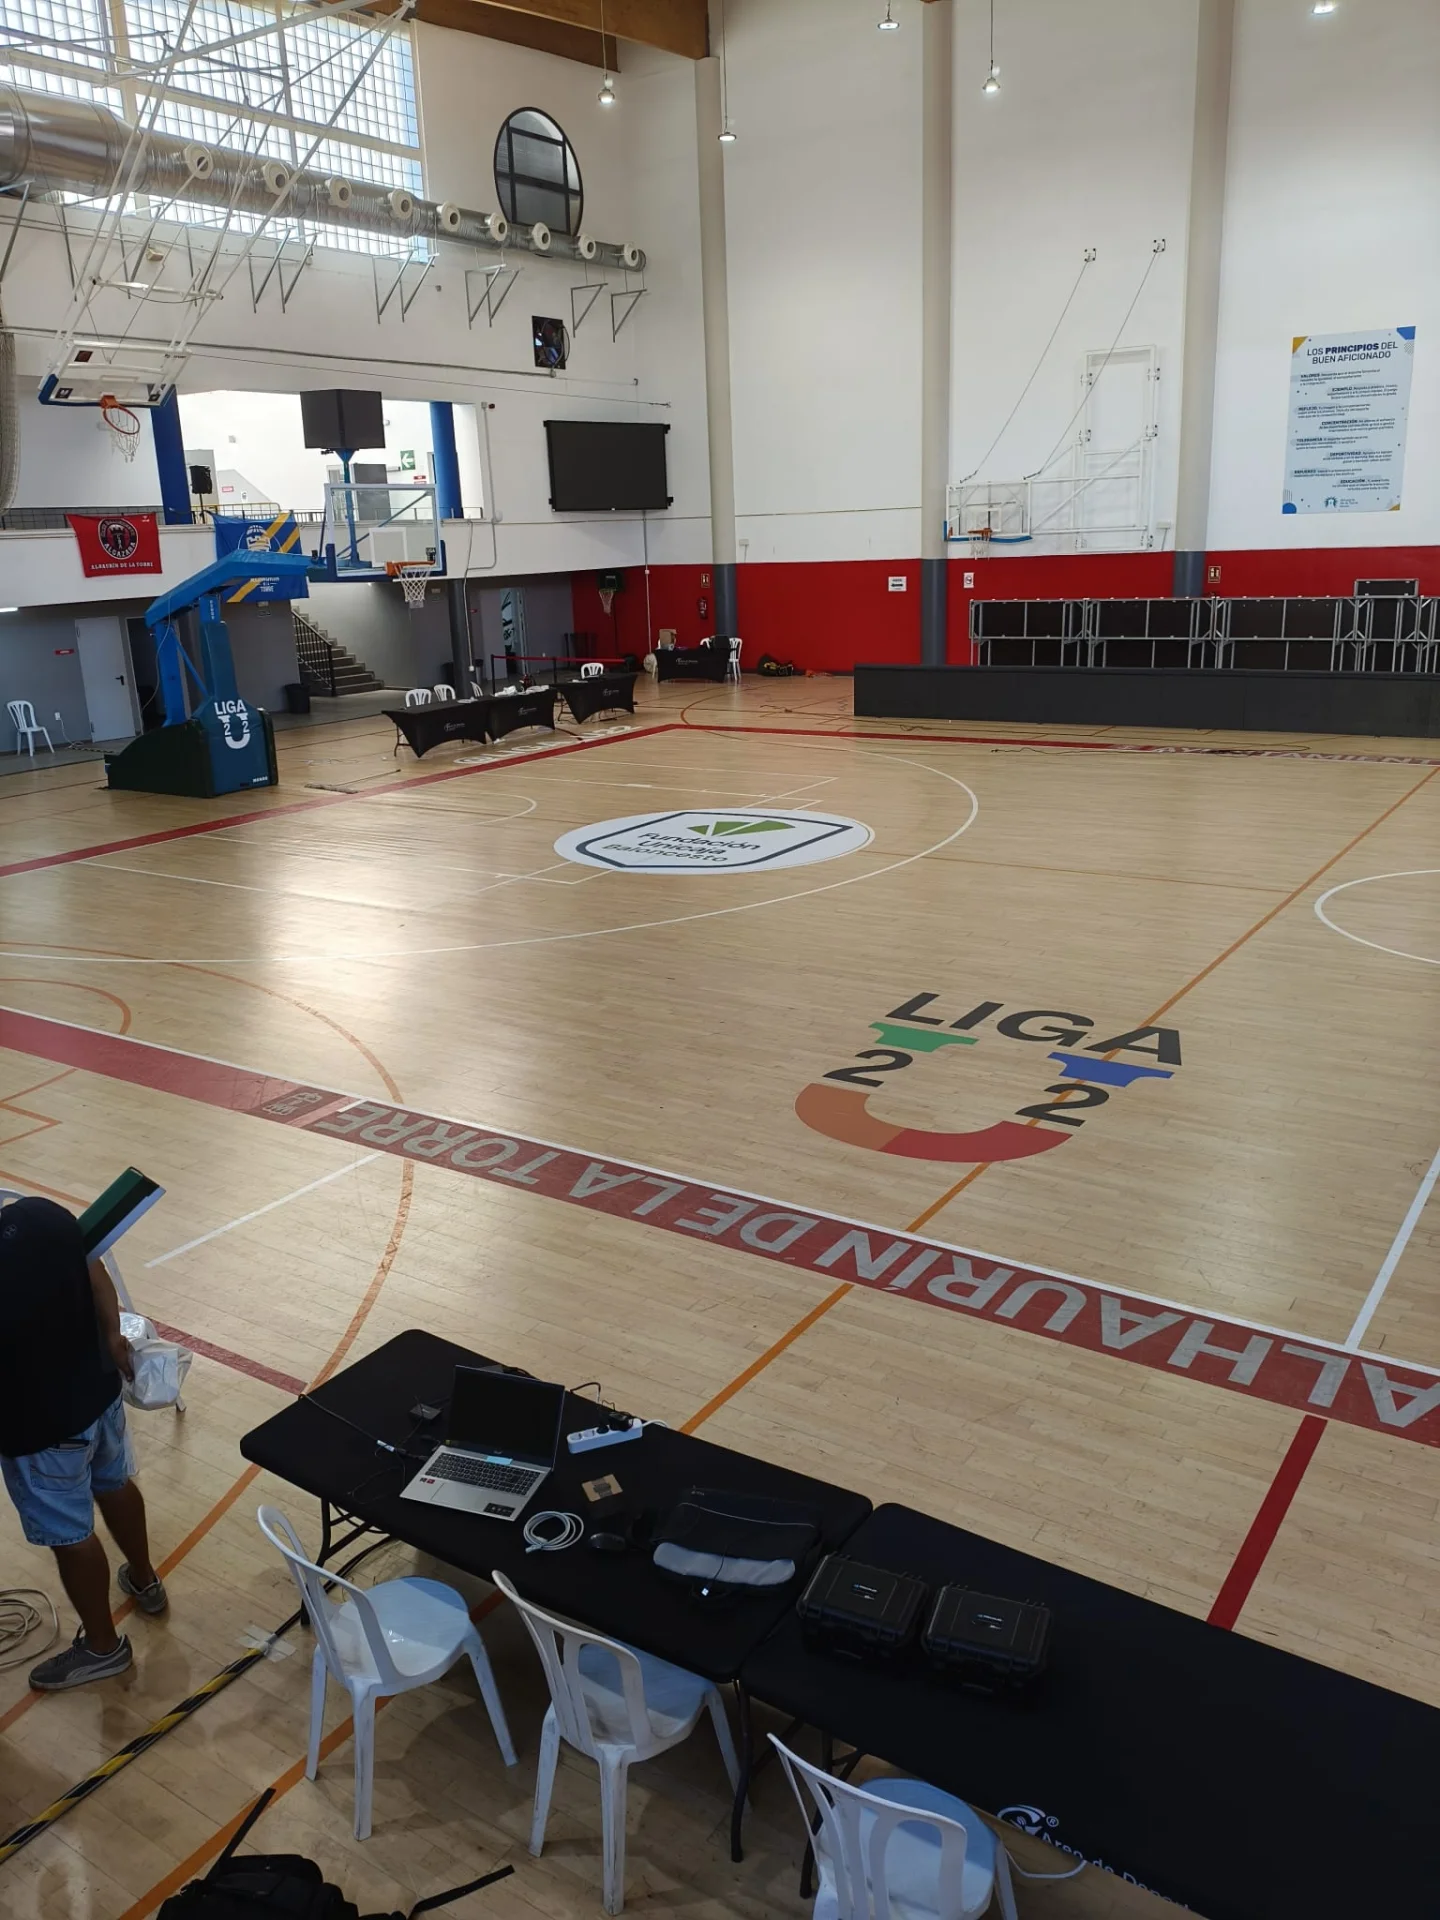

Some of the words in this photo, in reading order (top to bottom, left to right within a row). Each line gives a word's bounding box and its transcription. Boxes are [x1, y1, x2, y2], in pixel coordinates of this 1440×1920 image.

[1307, 348, 1324, 356] LOS
[1325, 343, 1379, 355] PRINCIPIOS
[1381, 341, 1398, 349] DEL
[1312, 356, 1336, 364] BUEN
[1337, 351, 1391, 362] AFICIONADO
[214, 699, 247, 715] LIGA
[638, 832, 761, 850] Fundación
[638, 840, 726, 855] Unicaja
[602, 844, 728, 862] Baloncesto
[886, 992, 1182, 1066] LIGA
[316, 1100, 562, 1185] TORRE
[568, 1160, 689, 1216] LA
[675, 1192, 822, 1254] DE
